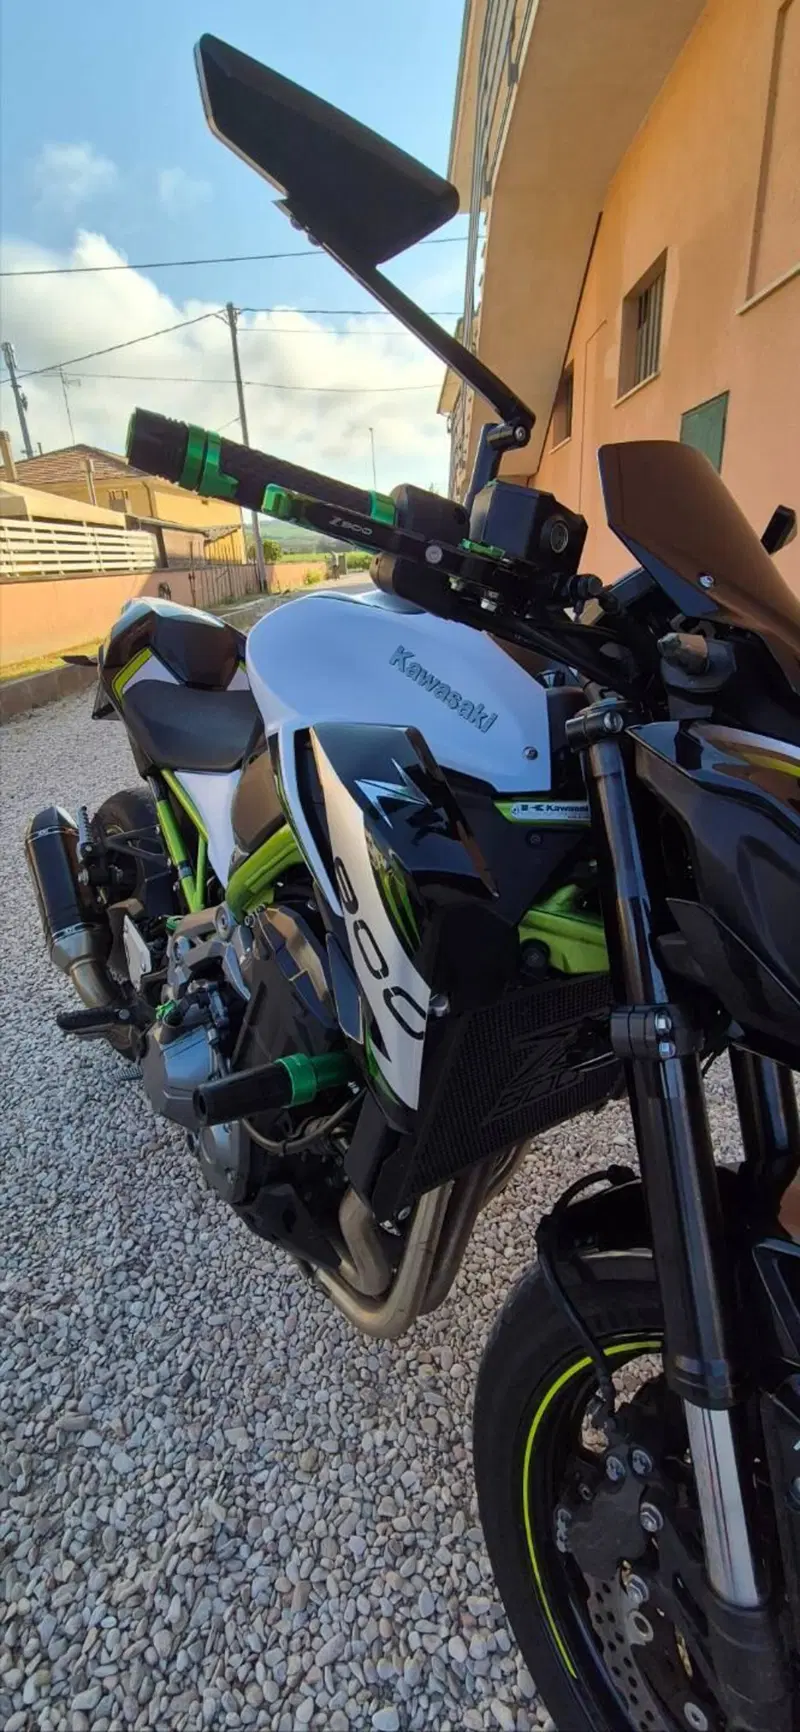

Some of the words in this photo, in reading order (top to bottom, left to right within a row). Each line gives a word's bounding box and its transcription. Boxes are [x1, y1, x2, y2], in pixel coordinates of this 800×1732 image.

[328, 515, 373, 536] Z900
[388, 644, 499, 734] Kawasaki
[334, 856, 427, 1041] 900
